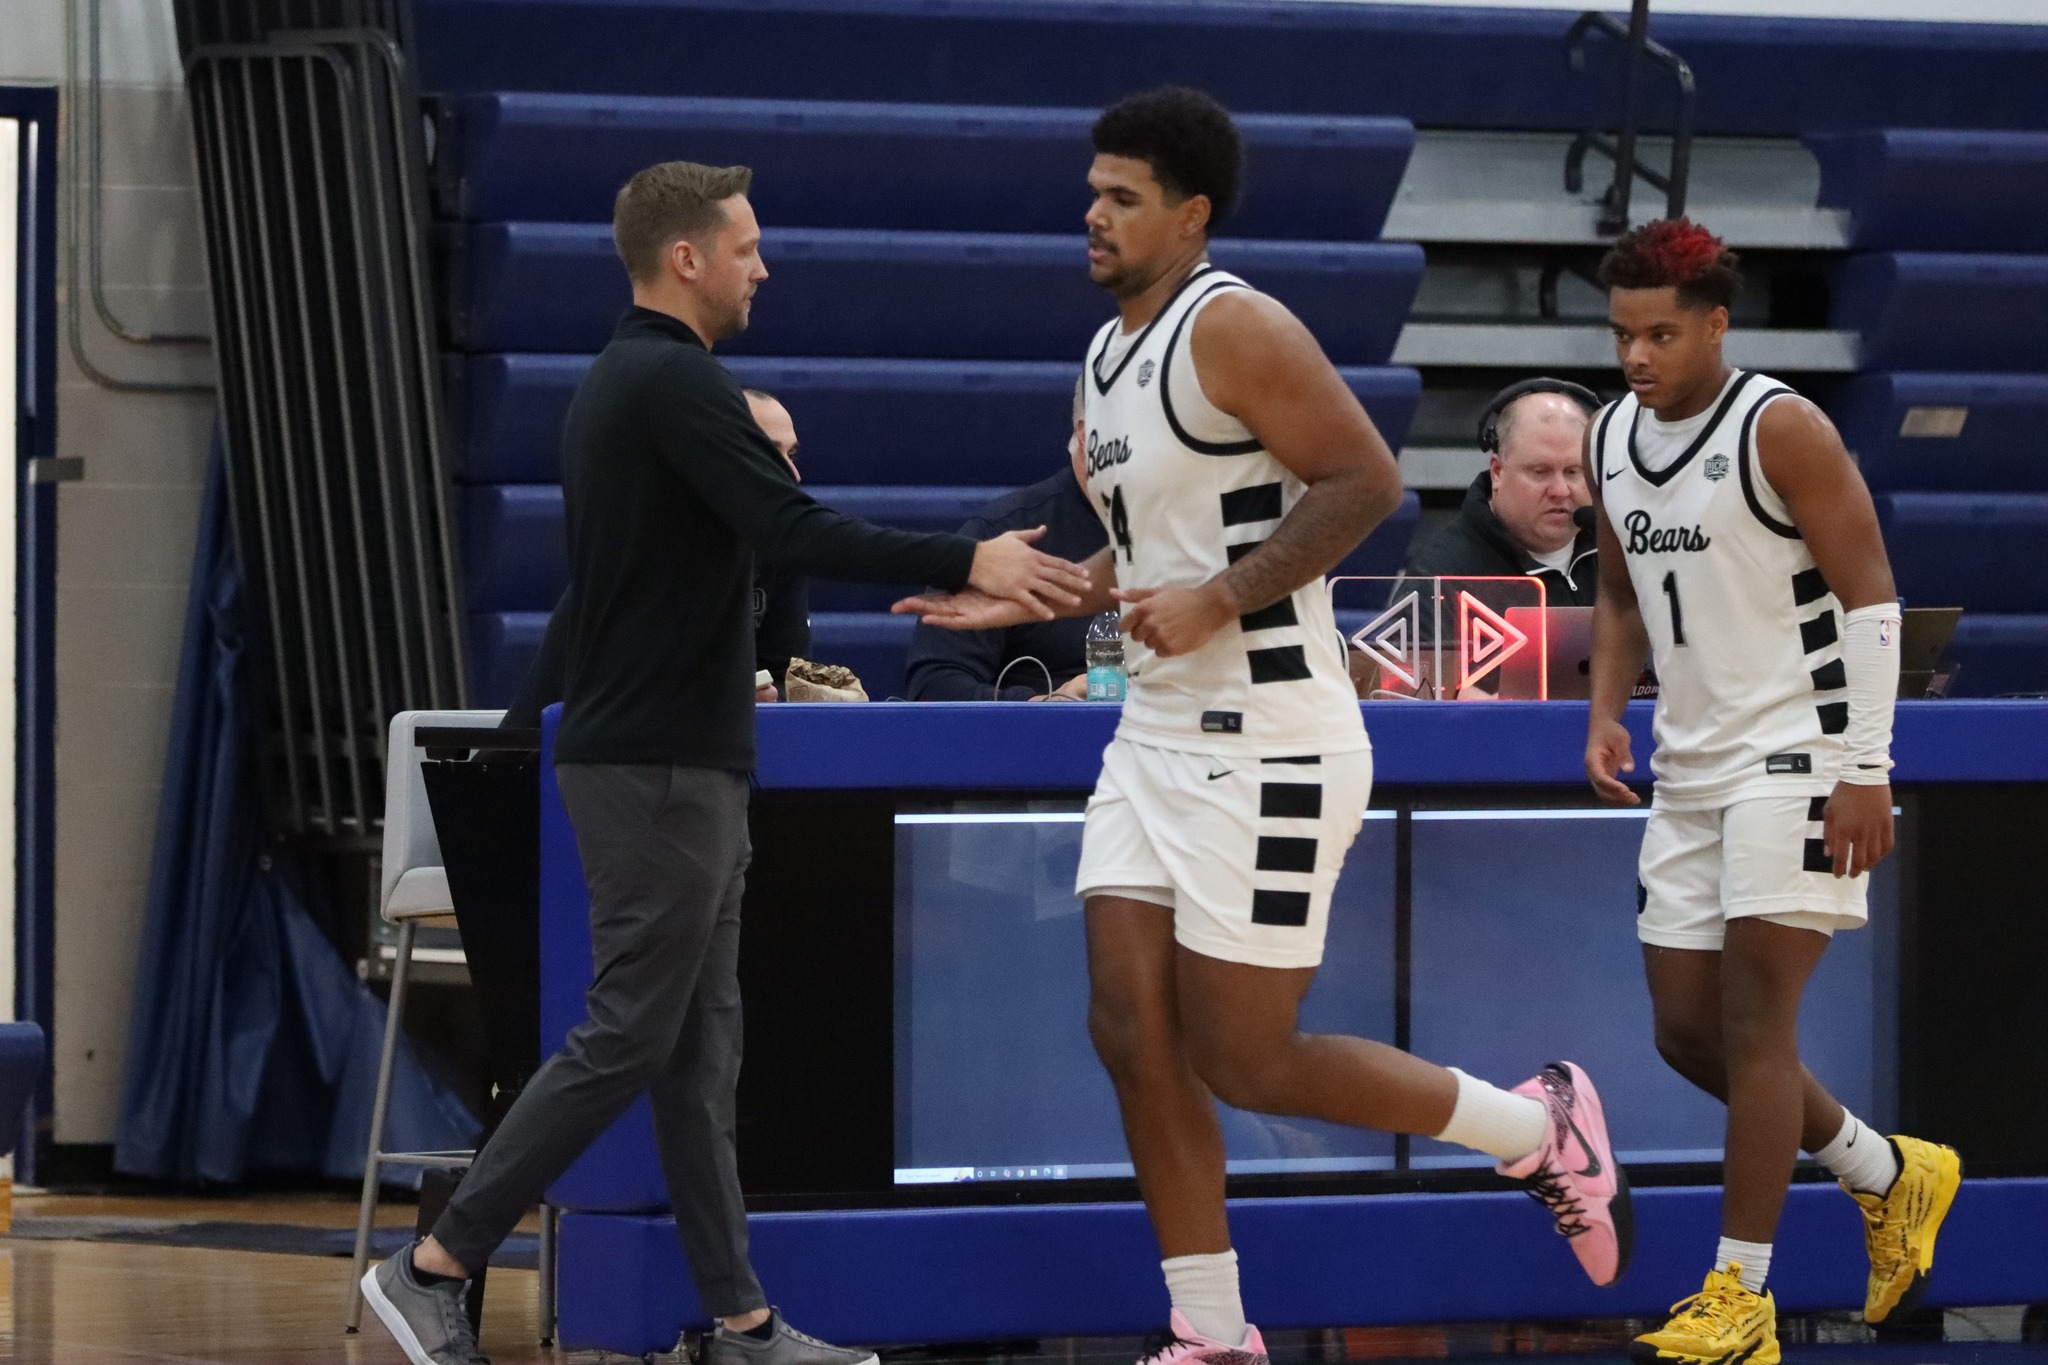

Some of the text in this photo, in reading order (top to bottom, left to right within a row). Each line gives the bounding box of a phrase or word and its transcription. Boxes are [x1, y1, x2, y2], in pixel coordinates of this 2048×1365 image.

[1087, 428, 1132, 477] Bears
[1624, 509, 1711, 555] Bears
[1662, 569, 1688, 648] 1
